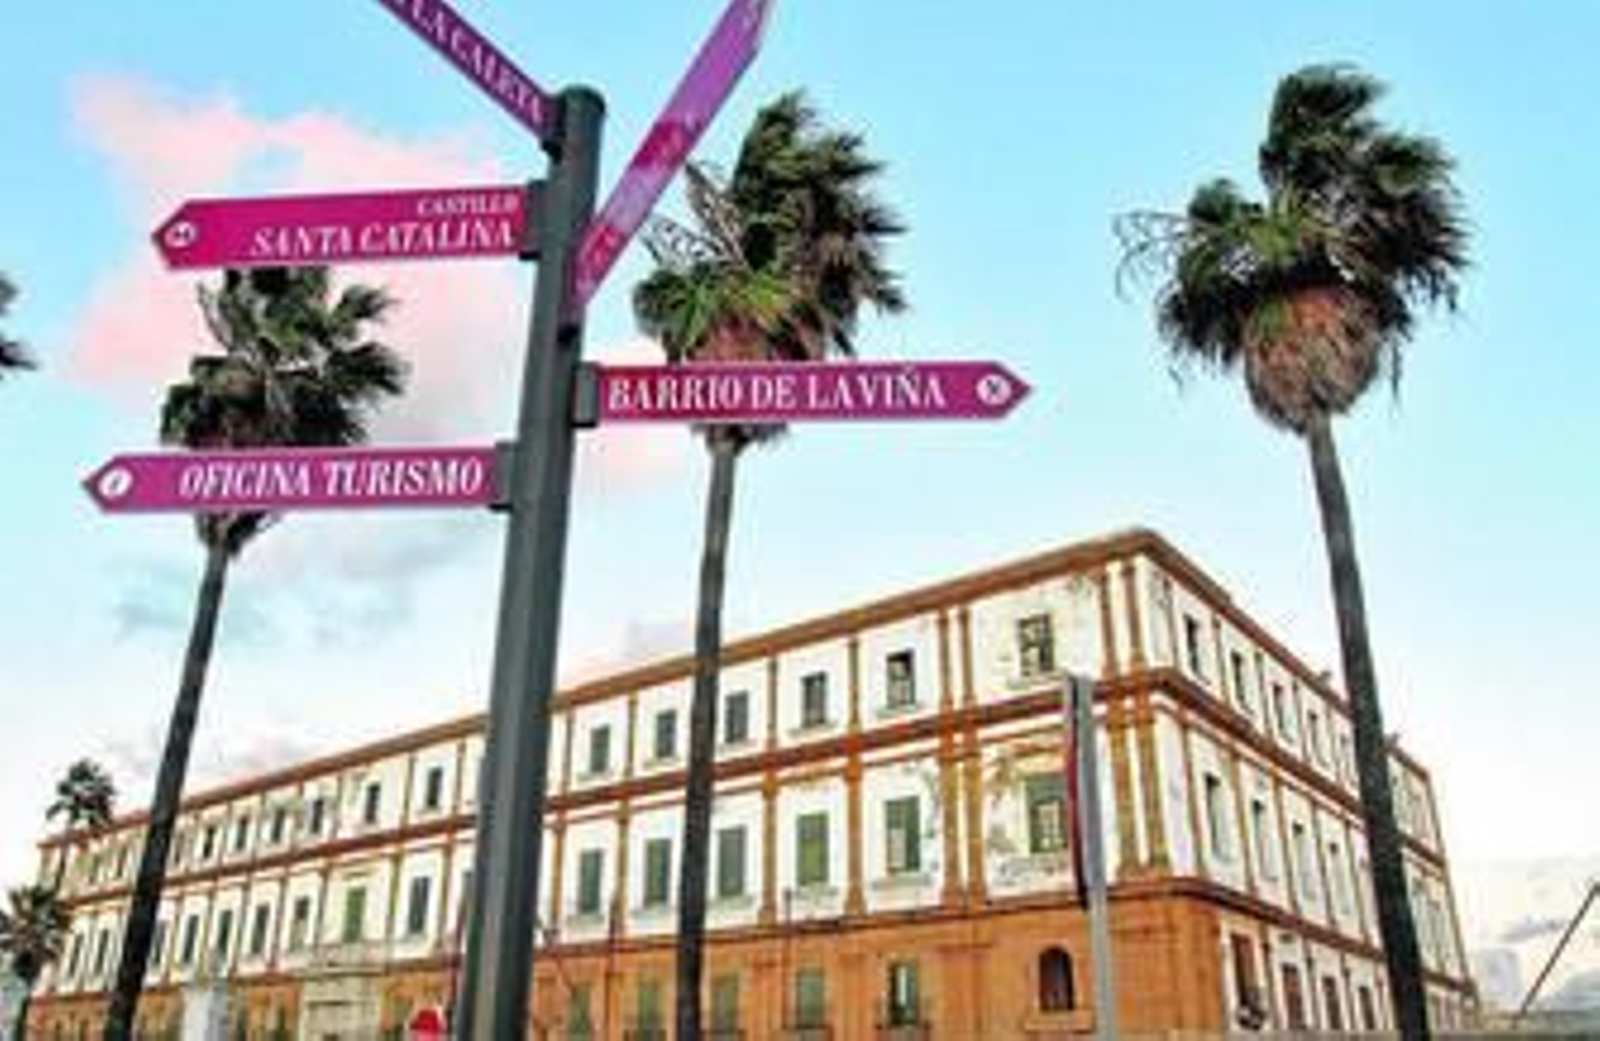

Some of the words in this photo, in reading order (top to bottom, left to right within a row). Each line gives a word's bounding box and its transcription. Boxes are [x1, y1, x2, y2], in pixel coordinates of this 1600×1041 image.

[451, 28, 544, 125] CALETA
[417, 194, 519, 216] CASTILLO
[251, 225, 351, 257] SANTA
[359, 219, 514, 254] CATALINA
[608, 375, 742, 411] BARRIO
[749, 374, 797, 408] DE
[808, 375, 853, 408] LA
[855, 364, 946, 408] VIÑA
[179, 460, 310, 498] OFICINA
[324, 457, 482, 496] TURISMO
